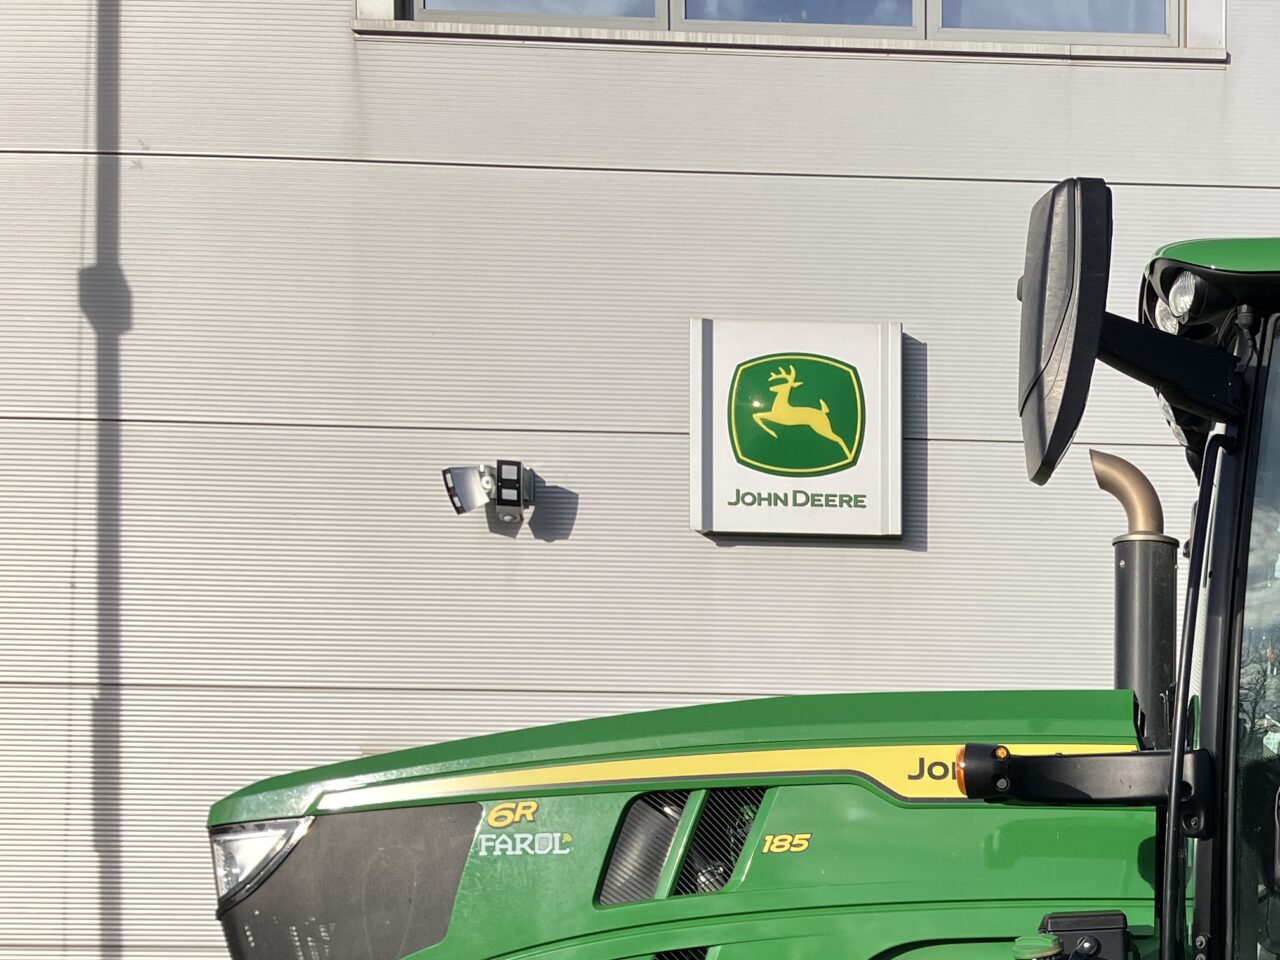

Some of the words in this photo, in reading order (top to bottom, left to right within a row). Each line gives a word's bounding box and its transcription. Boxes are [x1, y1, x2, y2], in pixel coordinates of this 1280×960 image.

[727, 488, 789, 507] JOHN
[792, 490, 867, 508] DEERE
[907, 757, 957, 781] JO
[487, 800, 539, 829] 6R
[478, 831, 571, 856] FAROL
[761, 833, 812, 854] 185
